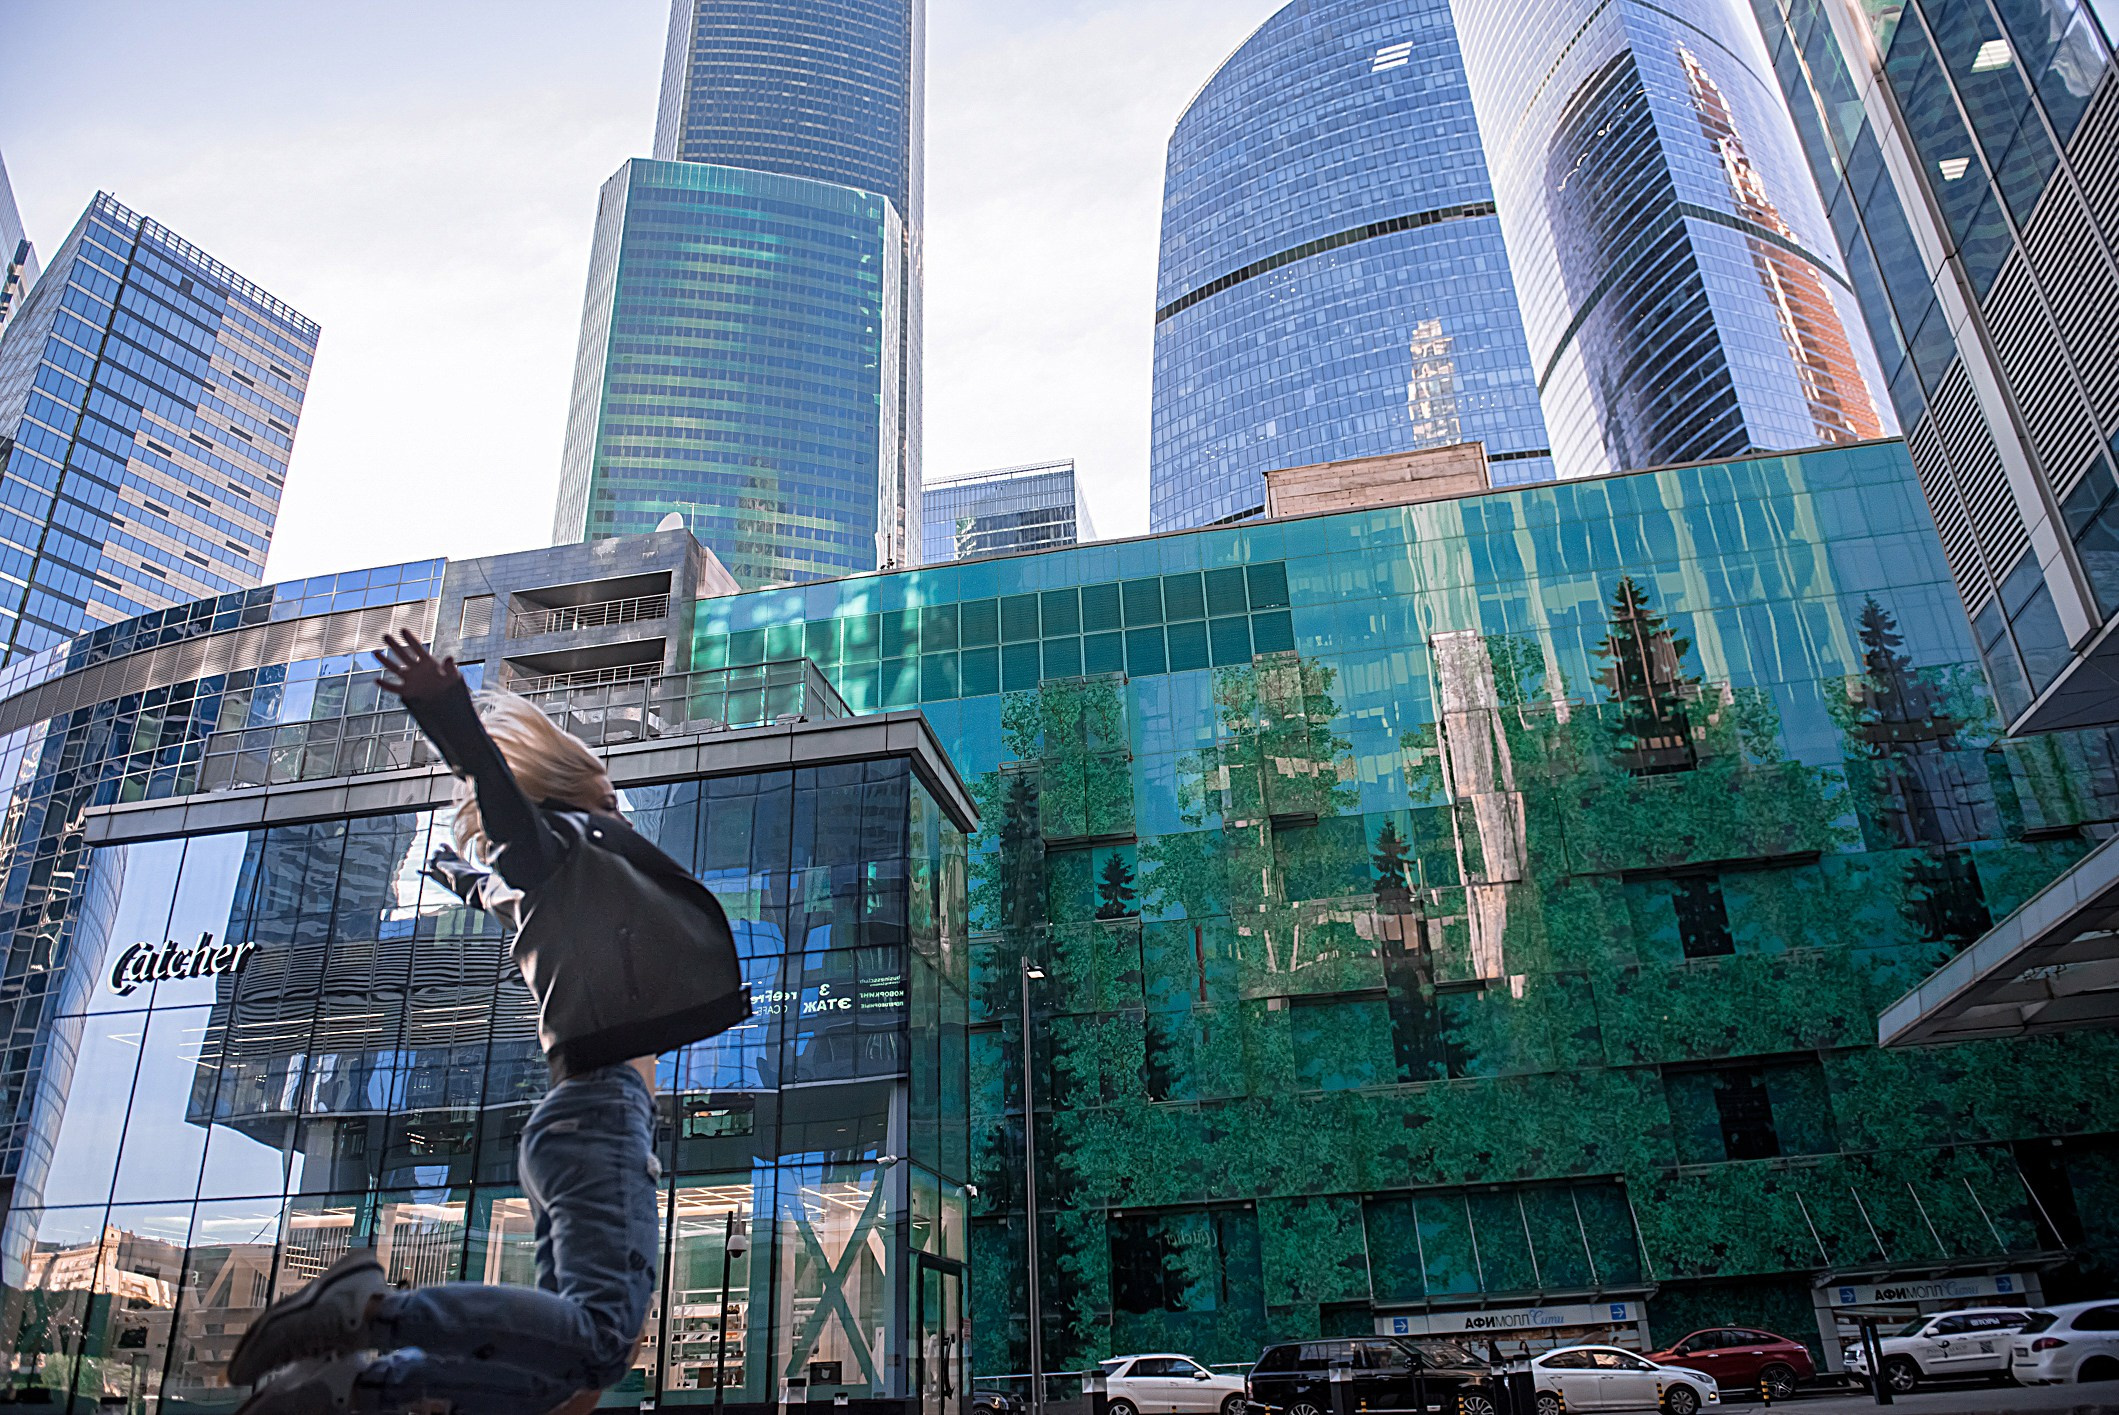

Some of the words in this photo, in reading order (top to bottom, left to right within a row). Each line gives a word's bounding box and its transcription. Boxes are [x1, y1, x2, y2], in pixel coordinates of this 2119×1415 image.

[107, 931, 258, 996] Catcher
[1875, 1284, 1944, 1301] АФИМОЛЛ
[1465, 1313, 1530, 1330] АФИМОЛЛ
[1529, 1308, 1565, 1326] Сити
